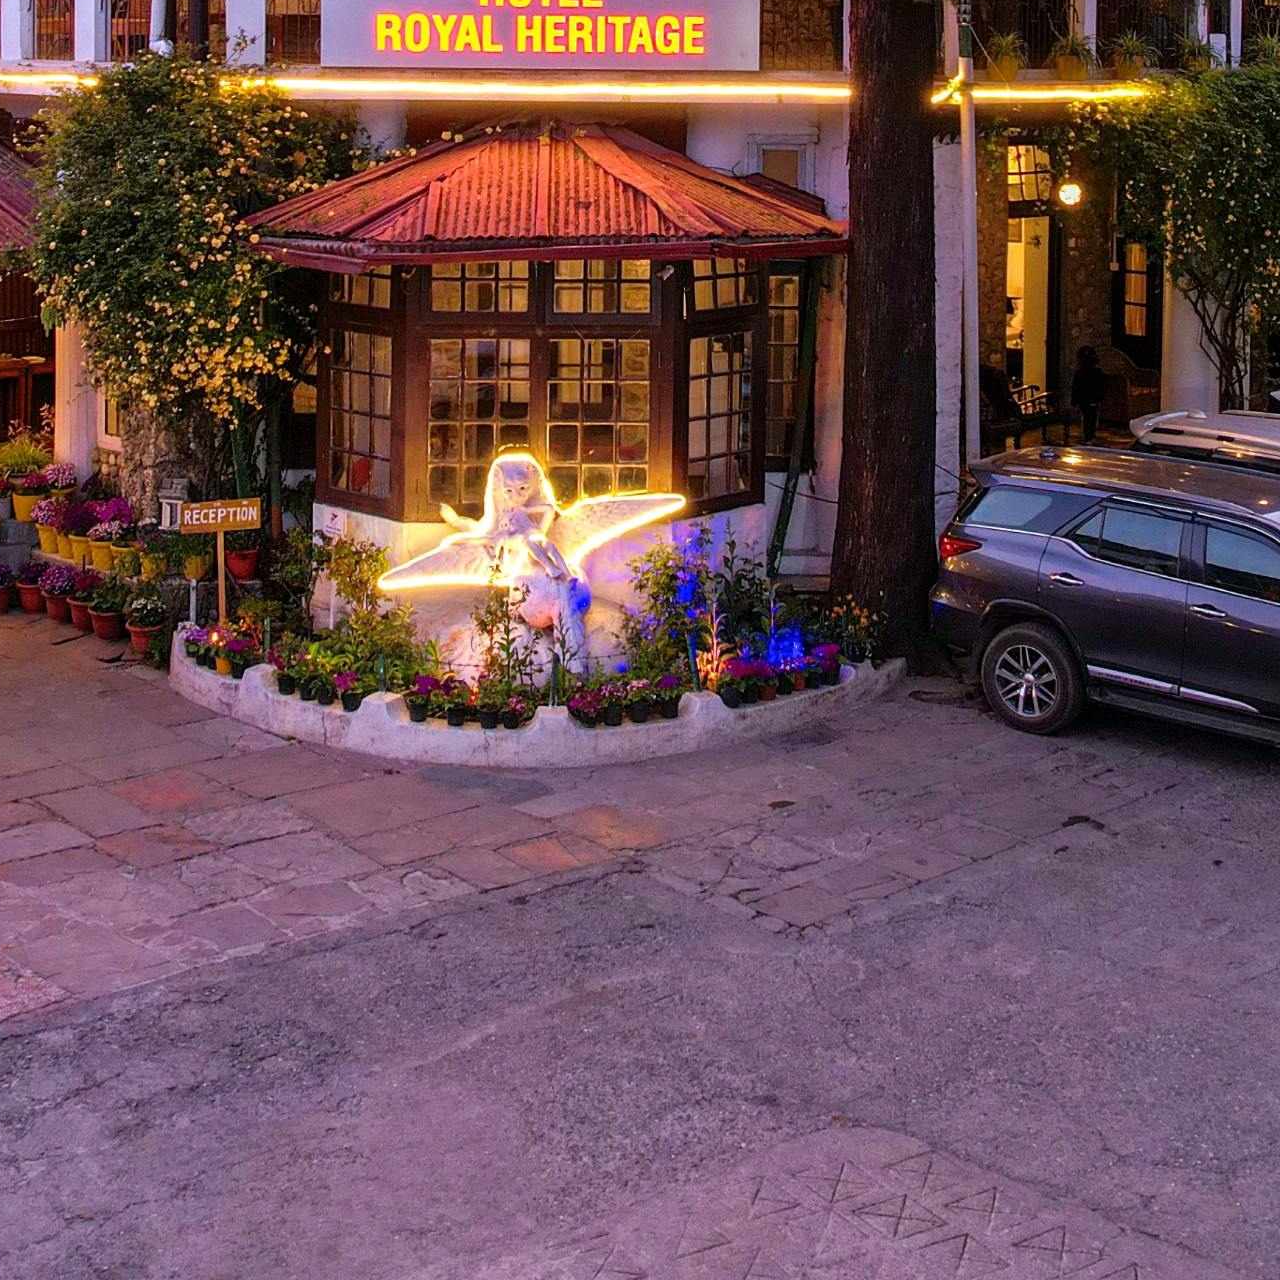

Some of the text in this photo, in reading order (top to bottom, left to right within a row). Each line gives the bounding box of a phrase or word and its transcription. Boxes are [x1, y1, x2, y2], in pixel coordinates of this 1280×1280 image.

[375, 12, 705, 55] ROYAL HERITAGE
[183, 506, 258, 526] RECEPTION
